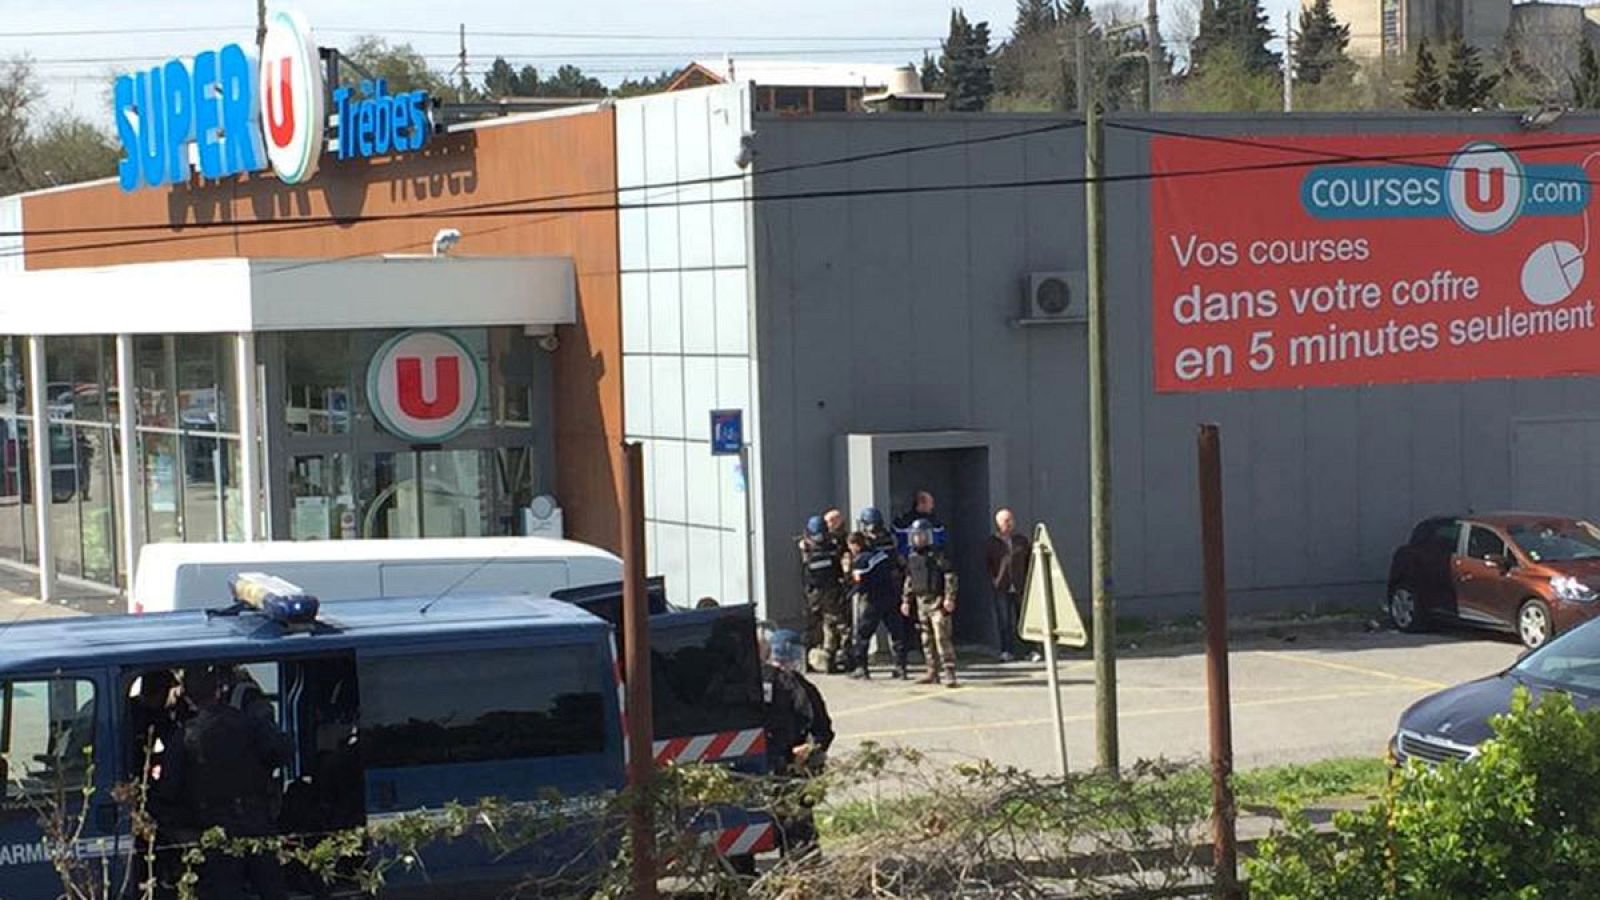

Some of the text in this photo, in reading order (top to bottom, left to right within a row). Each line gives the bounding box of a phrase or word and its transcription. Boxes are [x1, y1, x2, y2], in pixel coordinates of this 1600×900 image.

[114, 43, 429, 192] SUPER U Trèbes
[1171, 235, 1369, 267] Vos courses
[1174, 270, 1479, 324] dans votre coffre
[1175, 299, 1595, 380] en 5 minutes seulement
[396, 356, 460, 420] U
